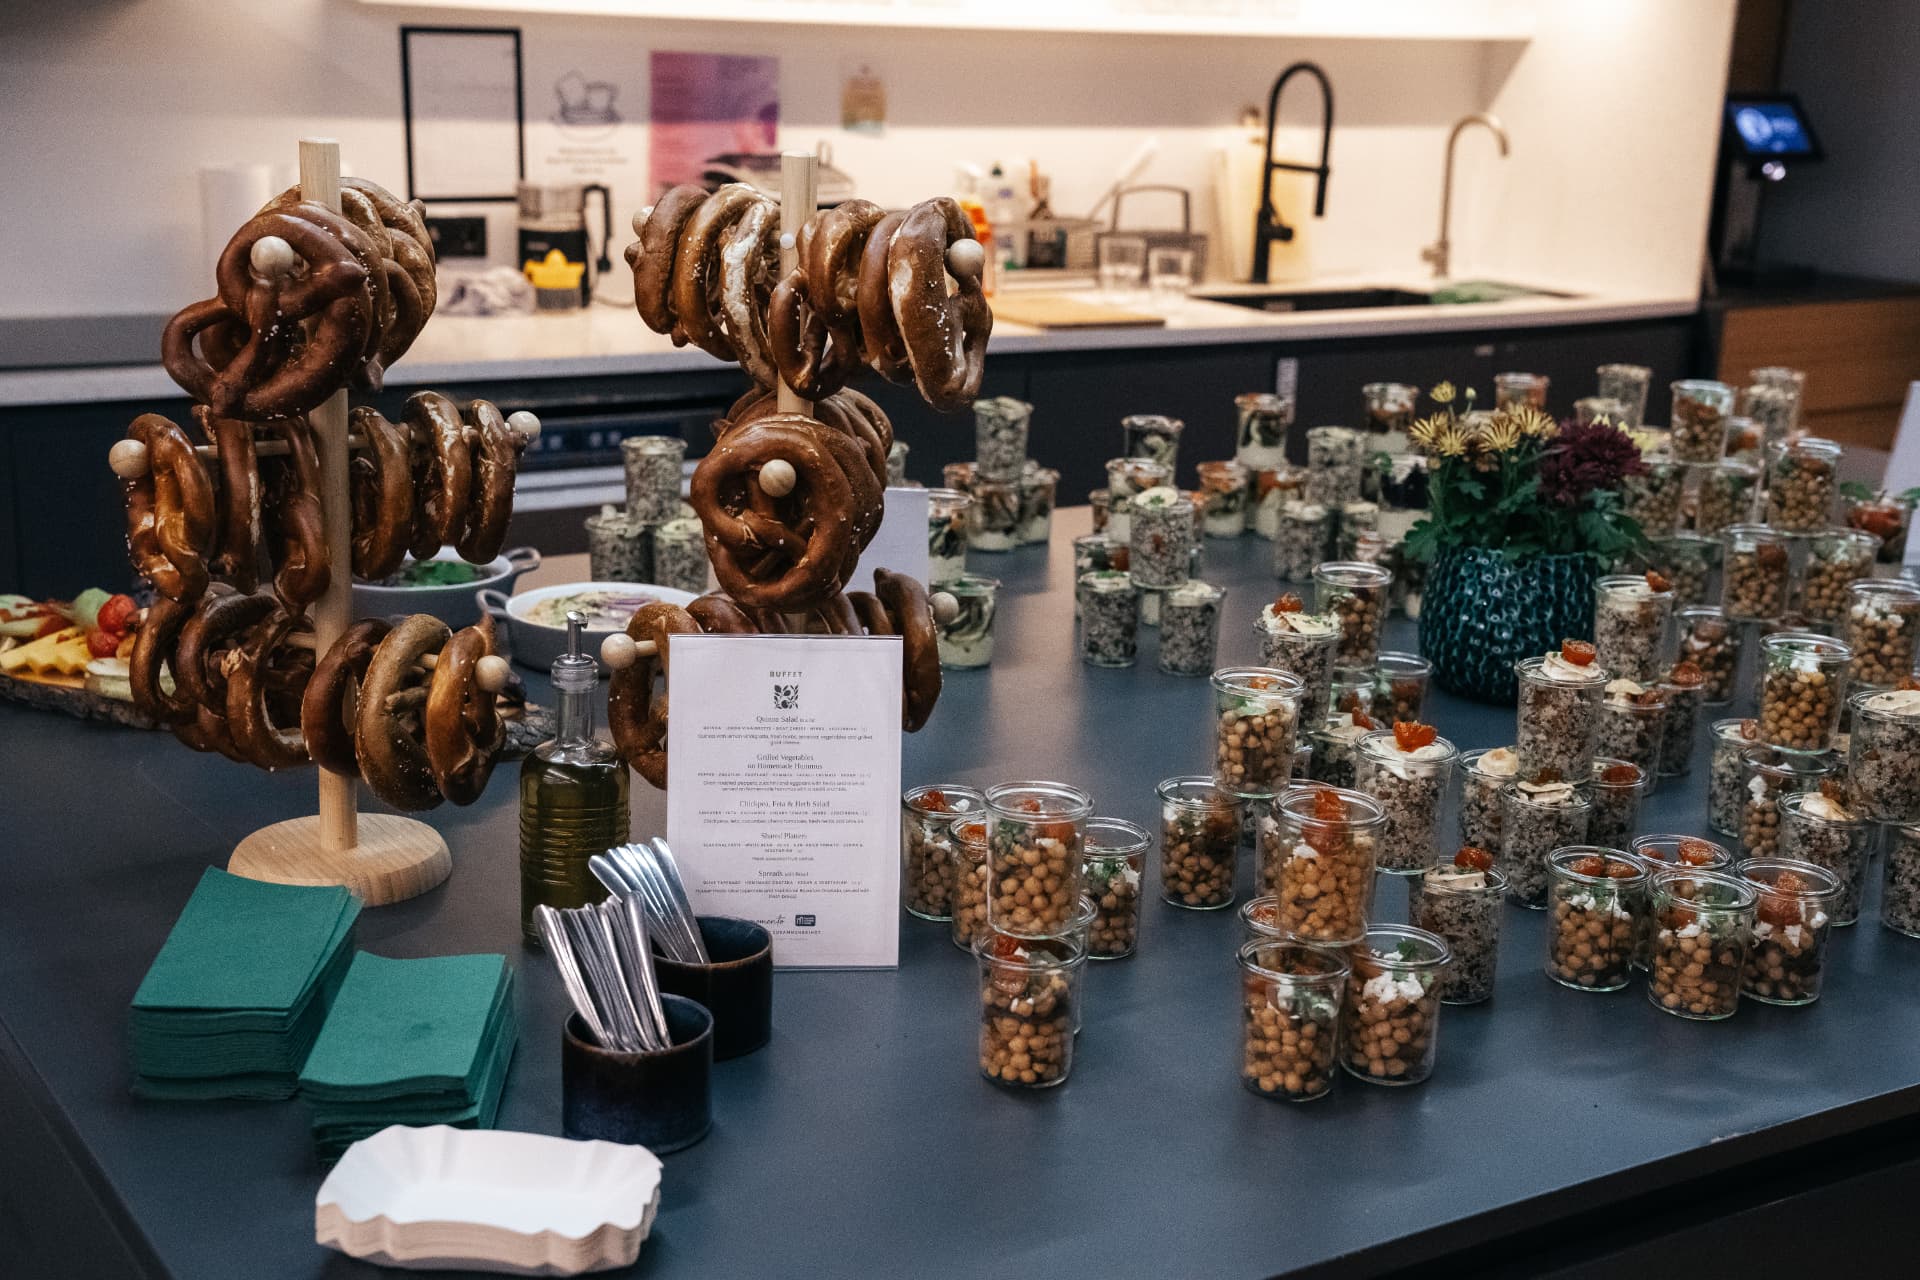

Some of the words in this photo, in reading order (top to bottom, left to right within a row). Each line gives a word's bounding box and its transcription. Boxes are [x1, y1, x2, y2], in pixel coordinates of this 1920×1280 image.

[756, 753, 779, 761] Grilled
[780, 753, 814, 762] Vegetables
[758, 870, 784, 879] Spreads
